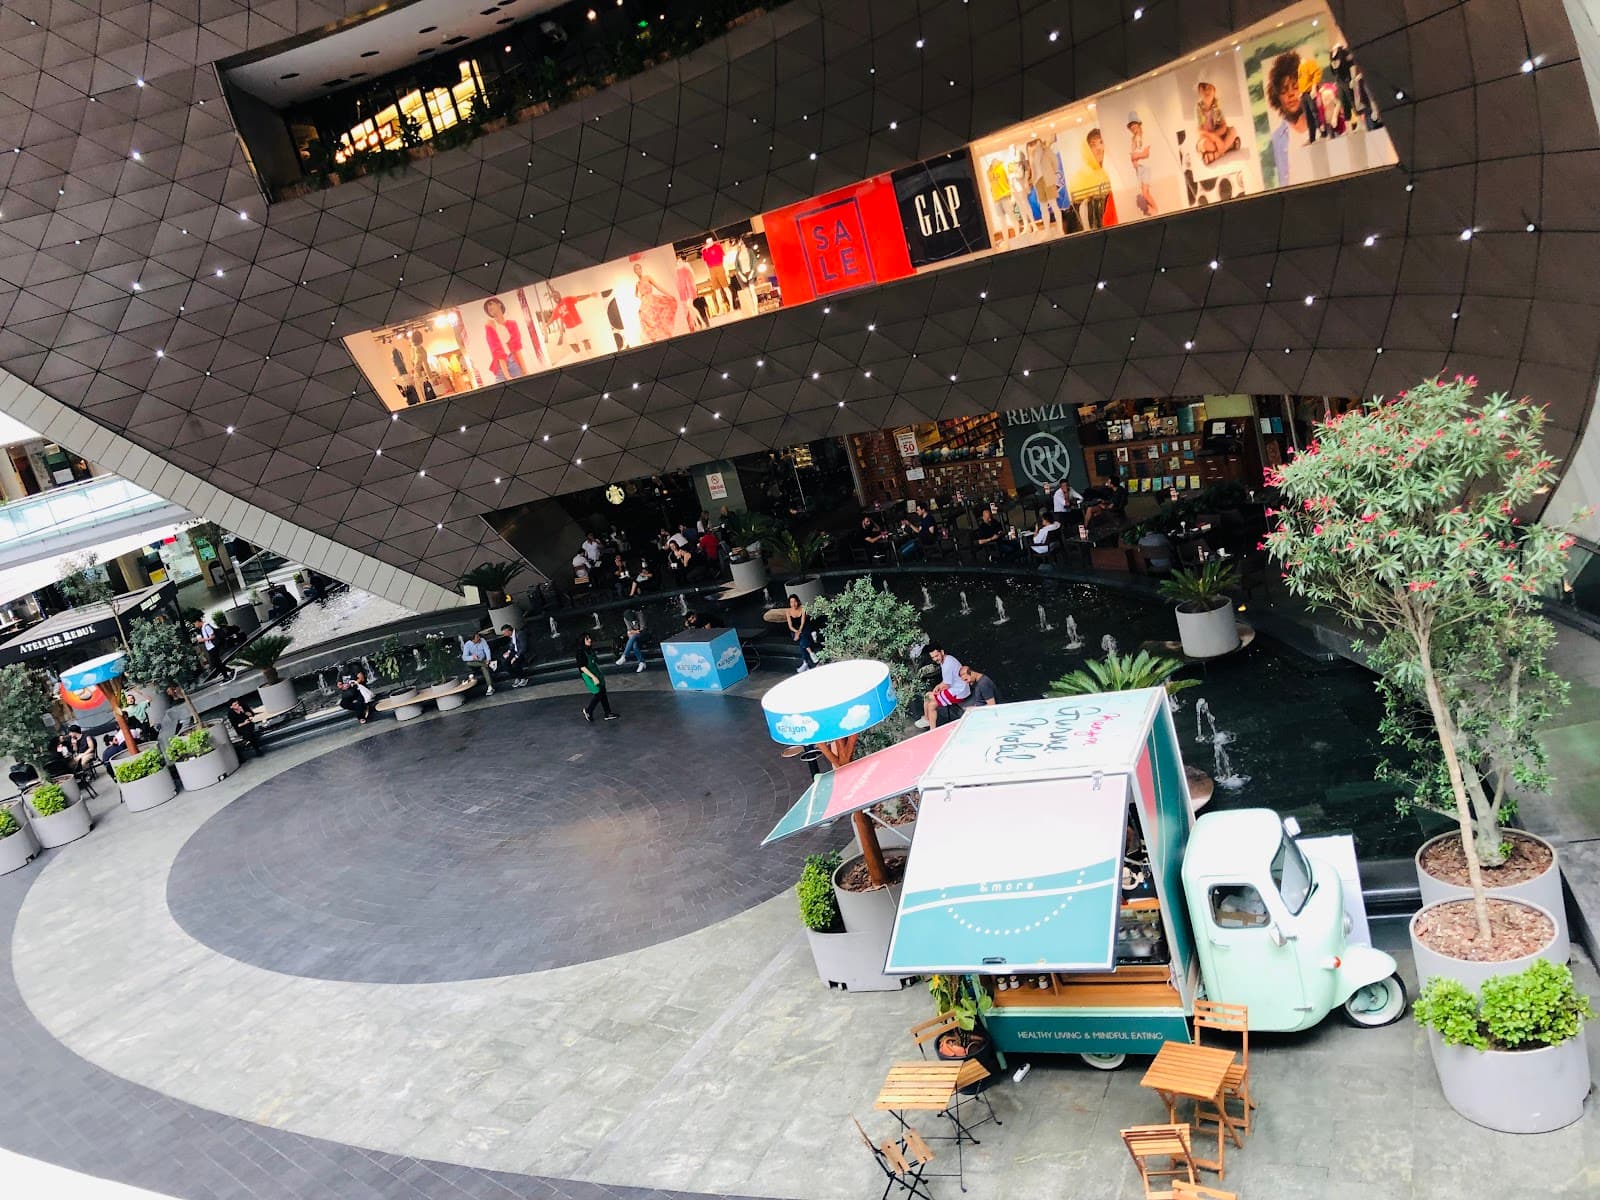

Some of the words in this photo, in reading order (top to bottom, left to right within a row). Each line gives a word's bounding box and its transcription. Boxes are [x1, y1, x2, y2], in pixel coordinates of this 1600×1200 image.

[914, 185, 961, 237] GAP
[812, 219, 851, 250] SA
[820, 248, 858, 281] LE
[903, 443, 915, 453] 50
[19, 634, 62, 655] ATELIER
[62, 625, 96, 642] REBUL
[1017, 1031, 1052, 1040] HEALTHY
[1054, 1031, 1082, 1040] LIVING
[1084, 1032, 1091, 1040] &
[1092, 1031, 1130, 1040] MINDFUL
[1131, 1032, 1164, 1041] EATING
